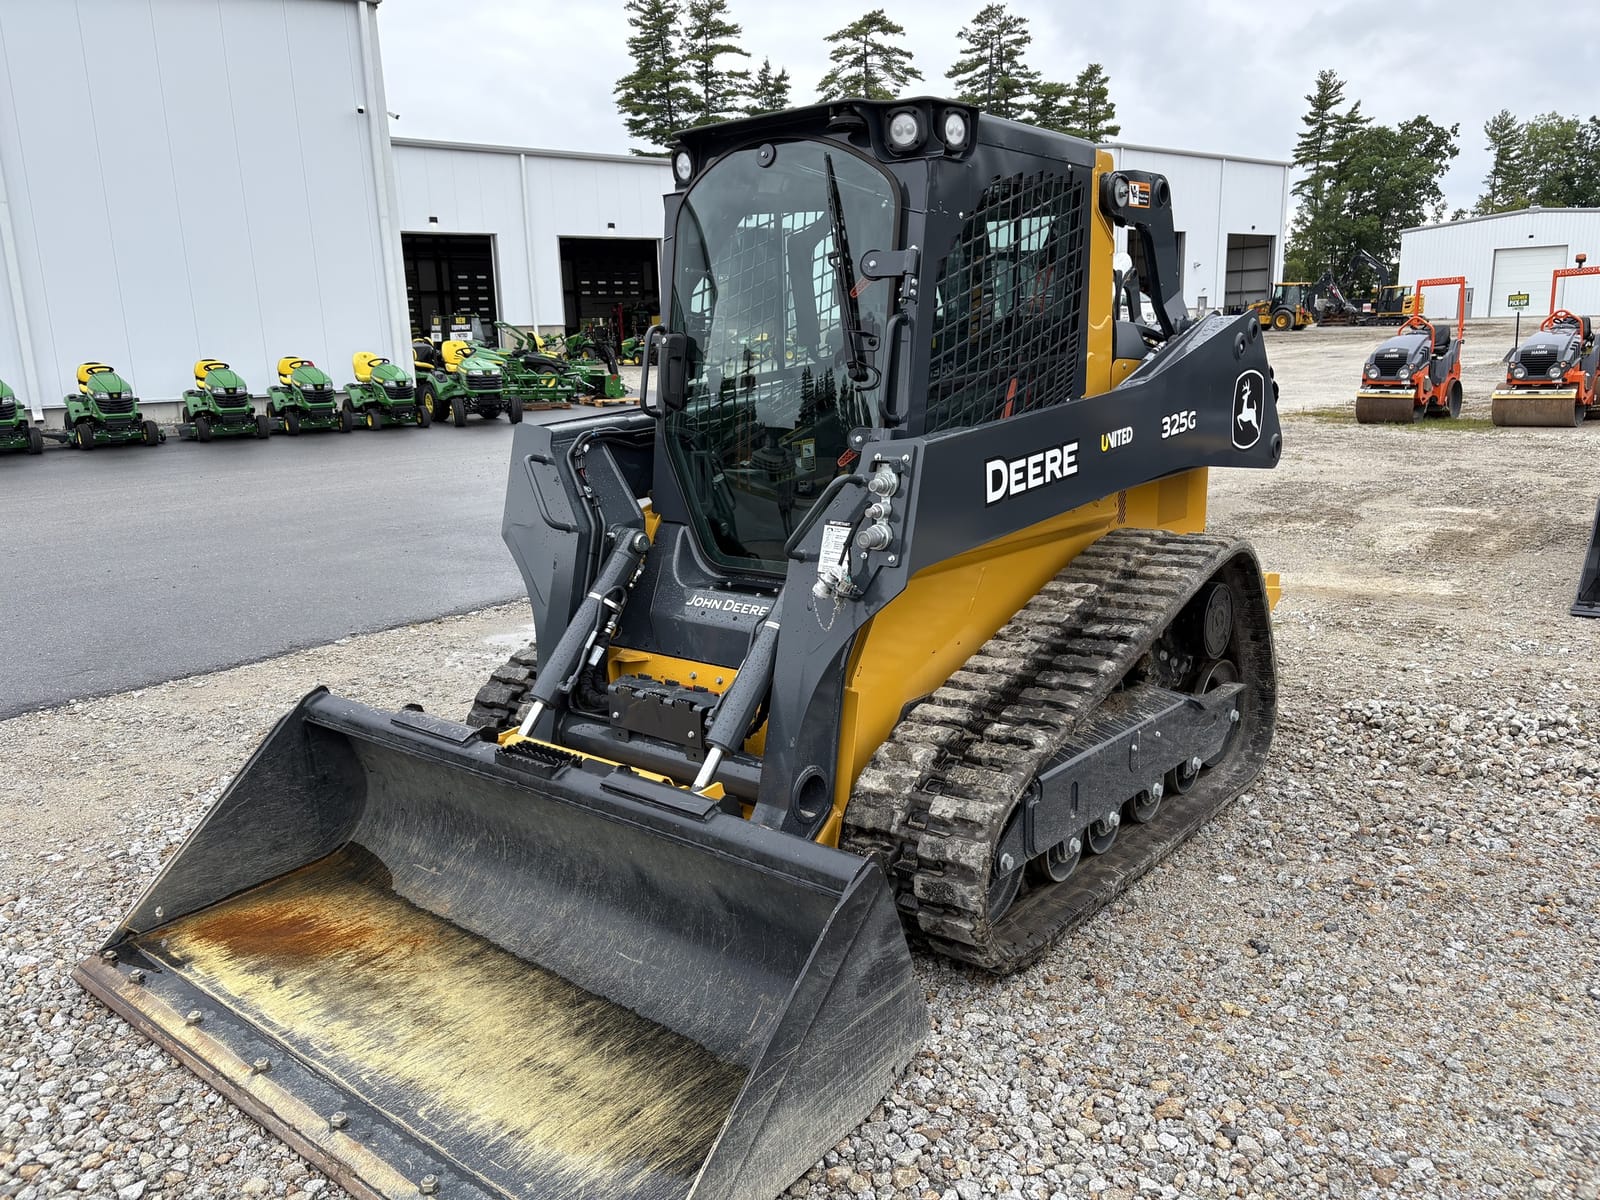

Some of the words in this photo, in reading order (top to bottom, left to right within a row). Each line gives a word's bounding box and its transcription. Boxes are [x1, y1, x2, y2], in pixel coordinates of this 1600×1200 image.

[1161, 411, 1197, 439] 325G
[1101, 426, 1133, 452] UNITED
[986, 442, 1078, 504] DEERE
[685, 594, 722, 610] JOHN
[722, 599, 769, 616] DEERE
